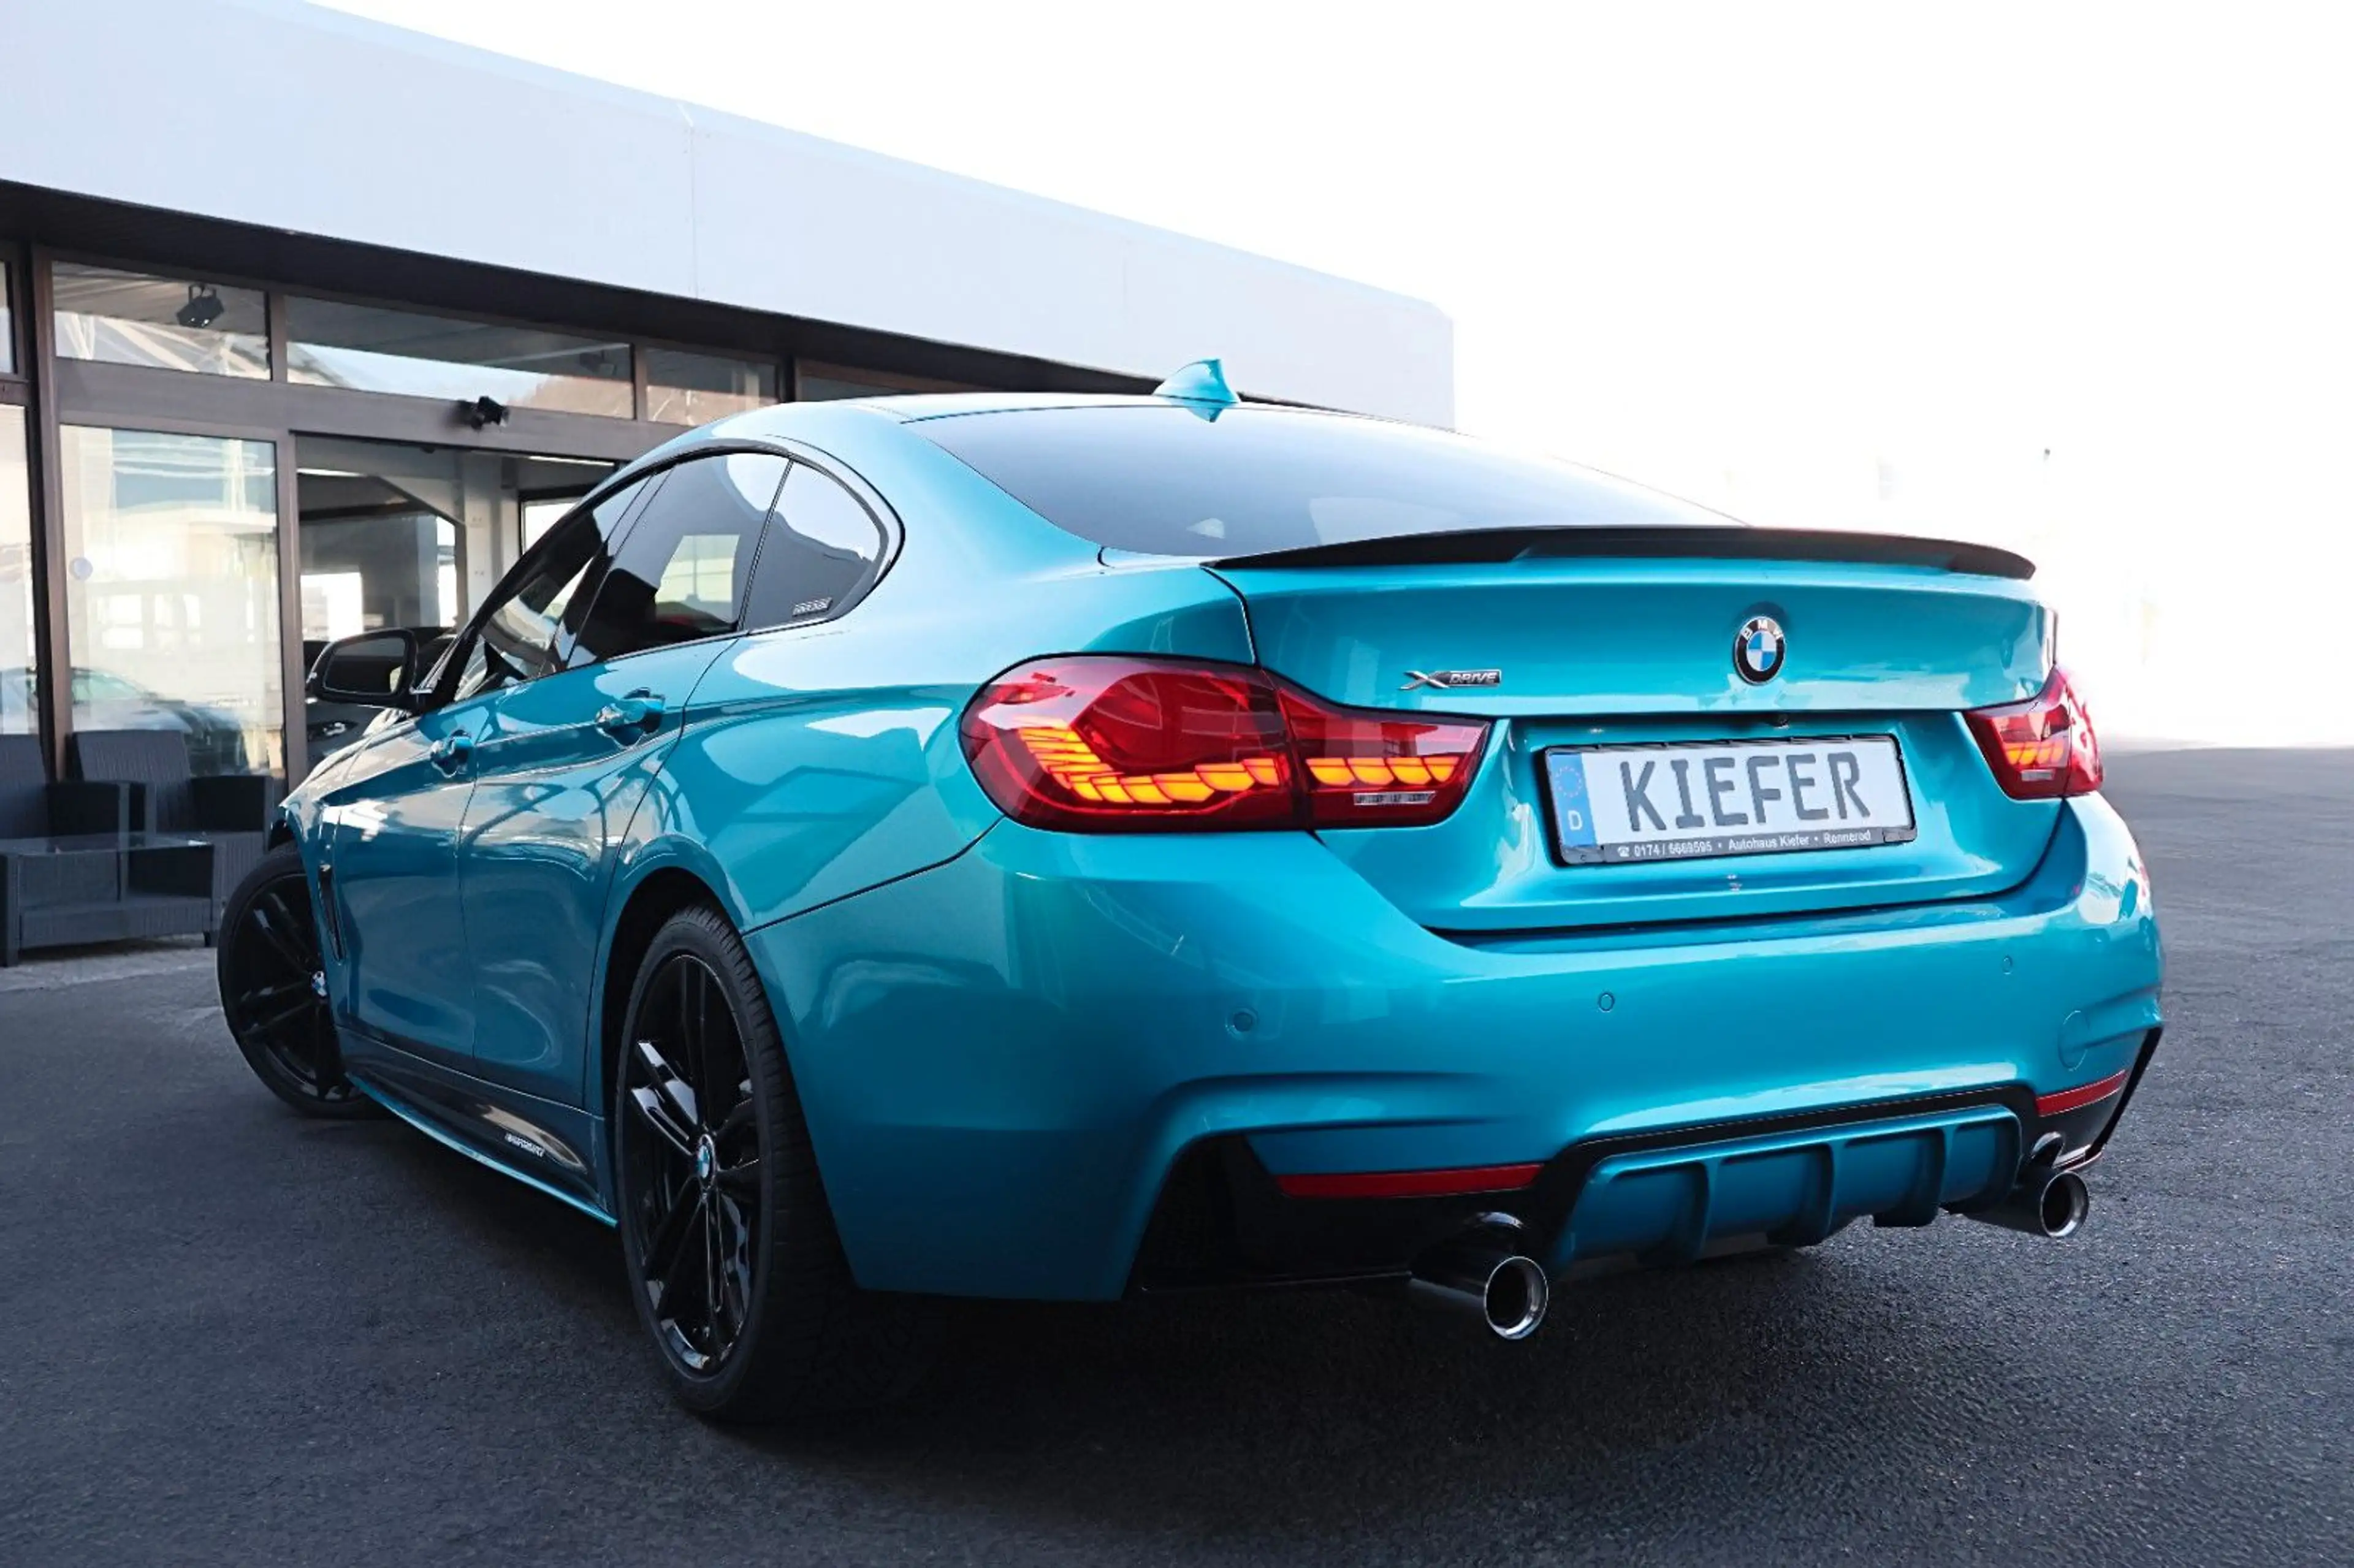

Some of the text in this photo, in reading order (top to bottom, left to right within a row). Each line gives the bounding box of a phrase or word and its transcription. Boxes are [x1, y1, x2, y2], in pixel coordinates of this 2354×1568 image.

[1740, 618, 1785, 641] BMW
[1619, 751, 1871, 832] KIEFER
[1567, 810, 1583, 831] D
[1728, 836, 1778, 851] Autohaus
[1779, 834, 1810, 848] Kiefer
